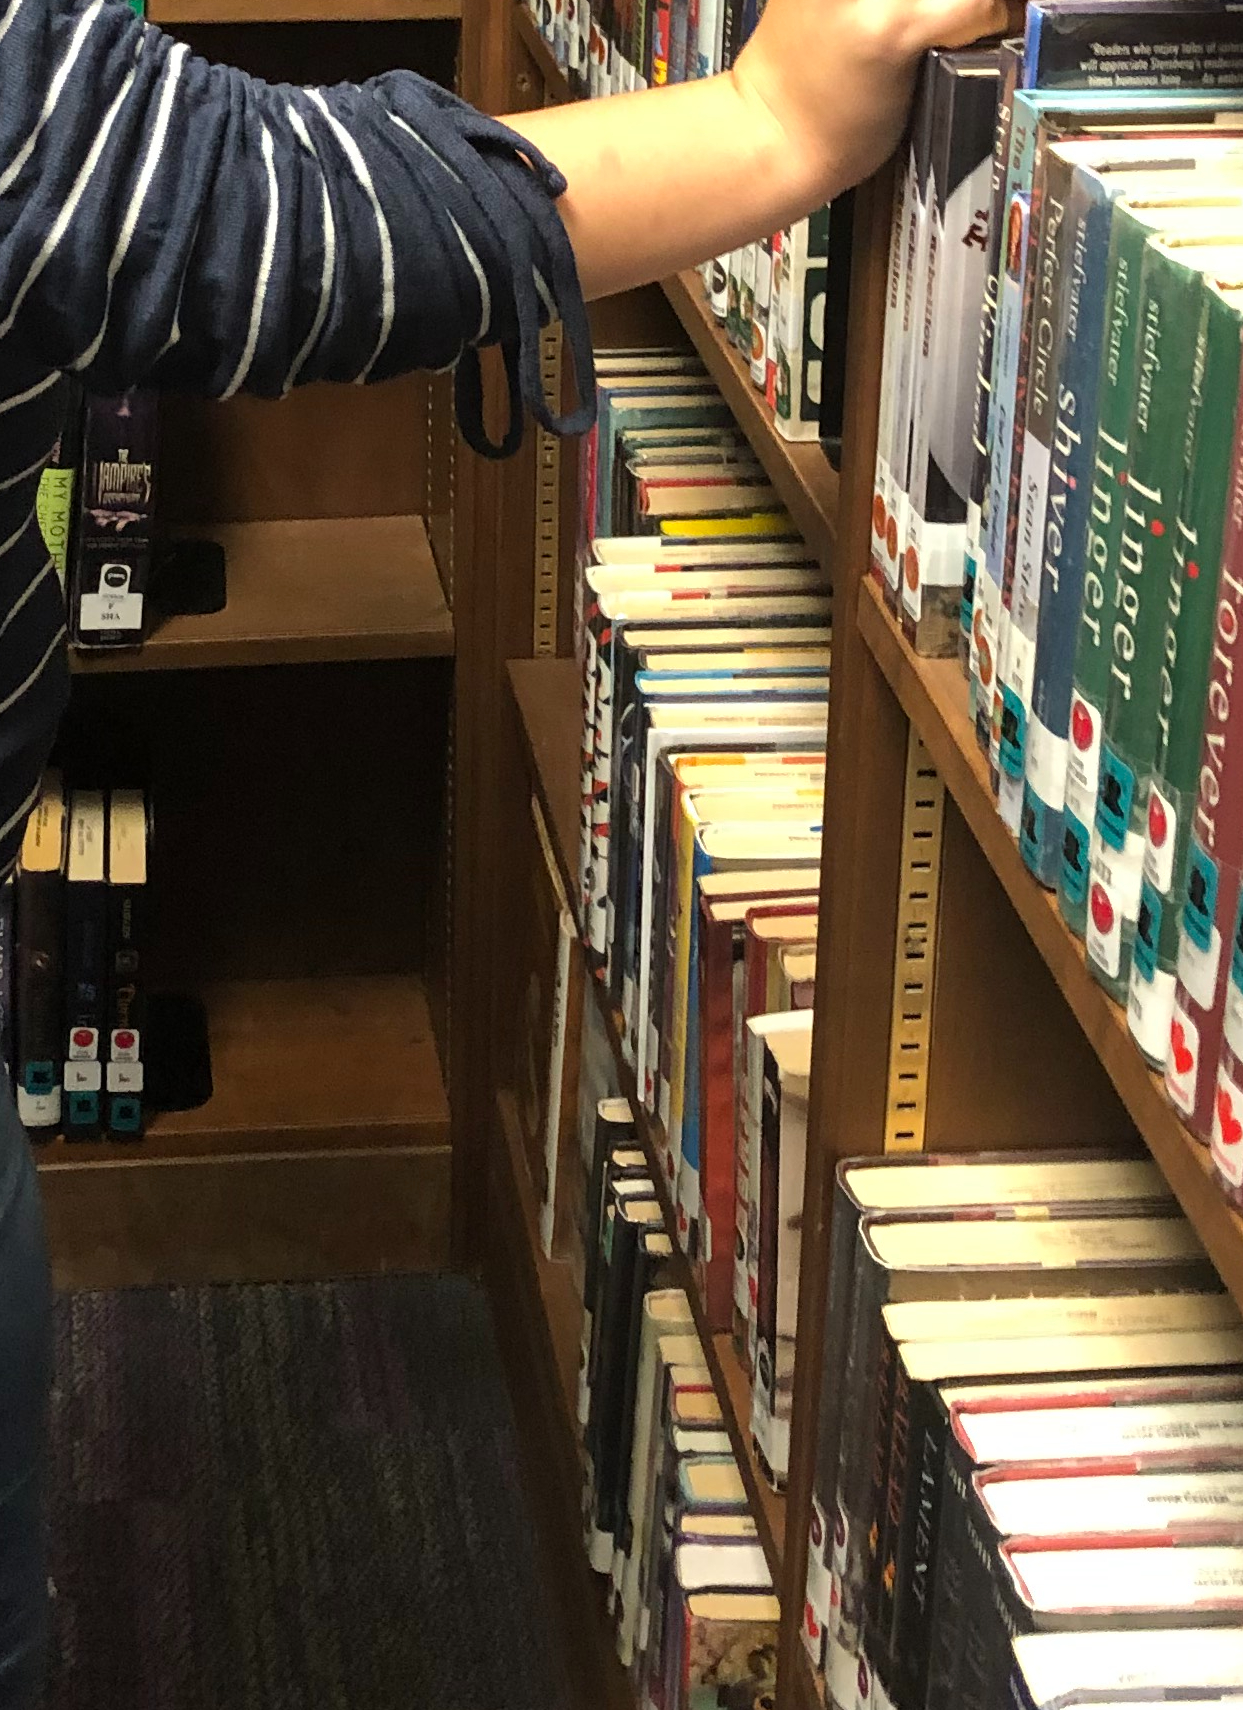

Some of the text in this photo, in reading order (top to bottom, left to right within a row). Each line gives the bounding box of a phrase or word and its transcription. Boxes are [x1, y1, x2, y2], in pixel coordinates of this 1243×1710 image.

[990, 102, 1013, 191] Stein
[921, 234, 940, 358] Rebellion
[1032, 195, 1066, 417] Perfect Circle
[1066, 217, 1091, 343] stiefvater
[1105, 257, 1132, 388] stiefvater
[1135, 298, 1162, 434] stiefvater
[52, 476, 69, 501] MY
[1042, 383, 1083, 594] shiver
[1080, 426, 1130, 648] linger
[1109, 473, 1166, 702] linger
[1195, 565, 1243, 848] forever
